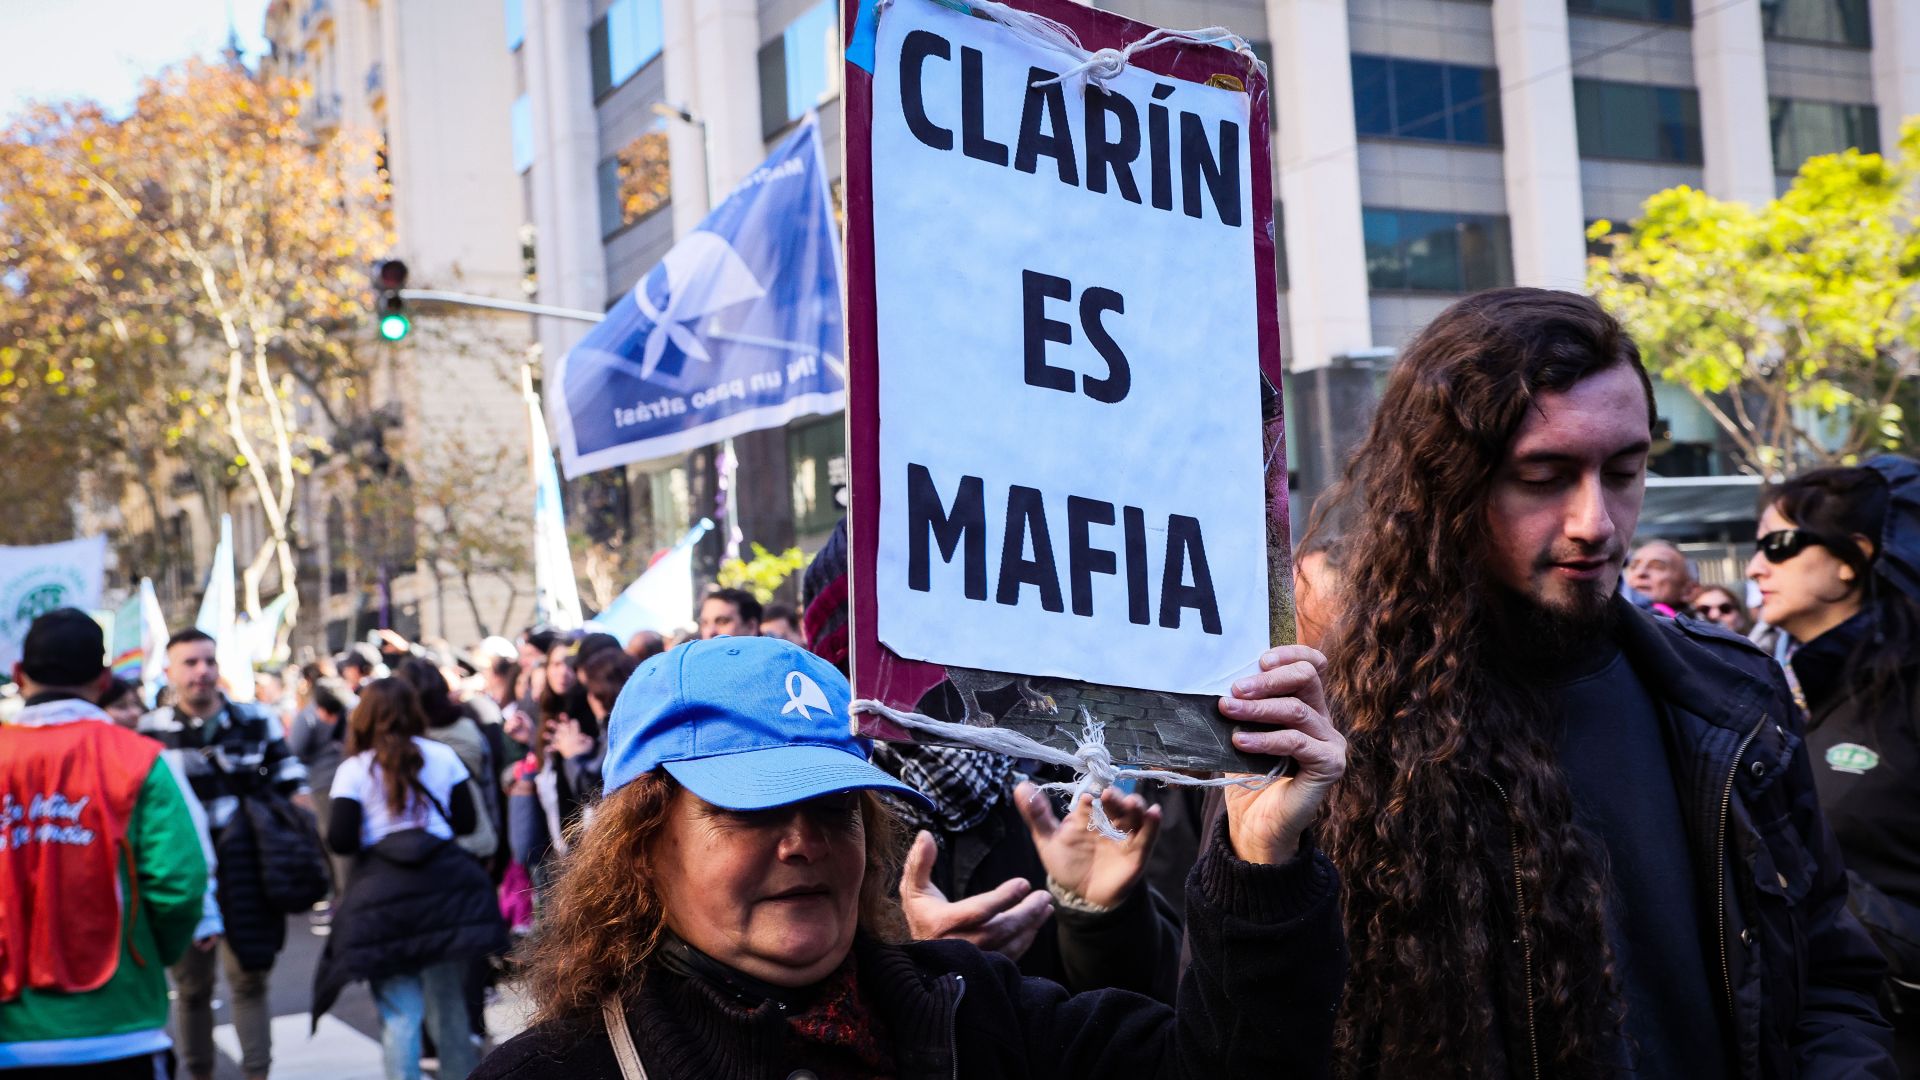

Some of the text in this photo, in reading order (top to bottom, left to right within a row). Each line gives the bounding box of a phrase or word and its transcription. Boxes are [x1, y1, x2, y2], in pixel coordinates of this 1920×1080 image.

[899, 29, 1242, 228] CLARÍN
[1021, 268, 1132, 404] ES
[907, 462, 1223, 636] MAFIA
